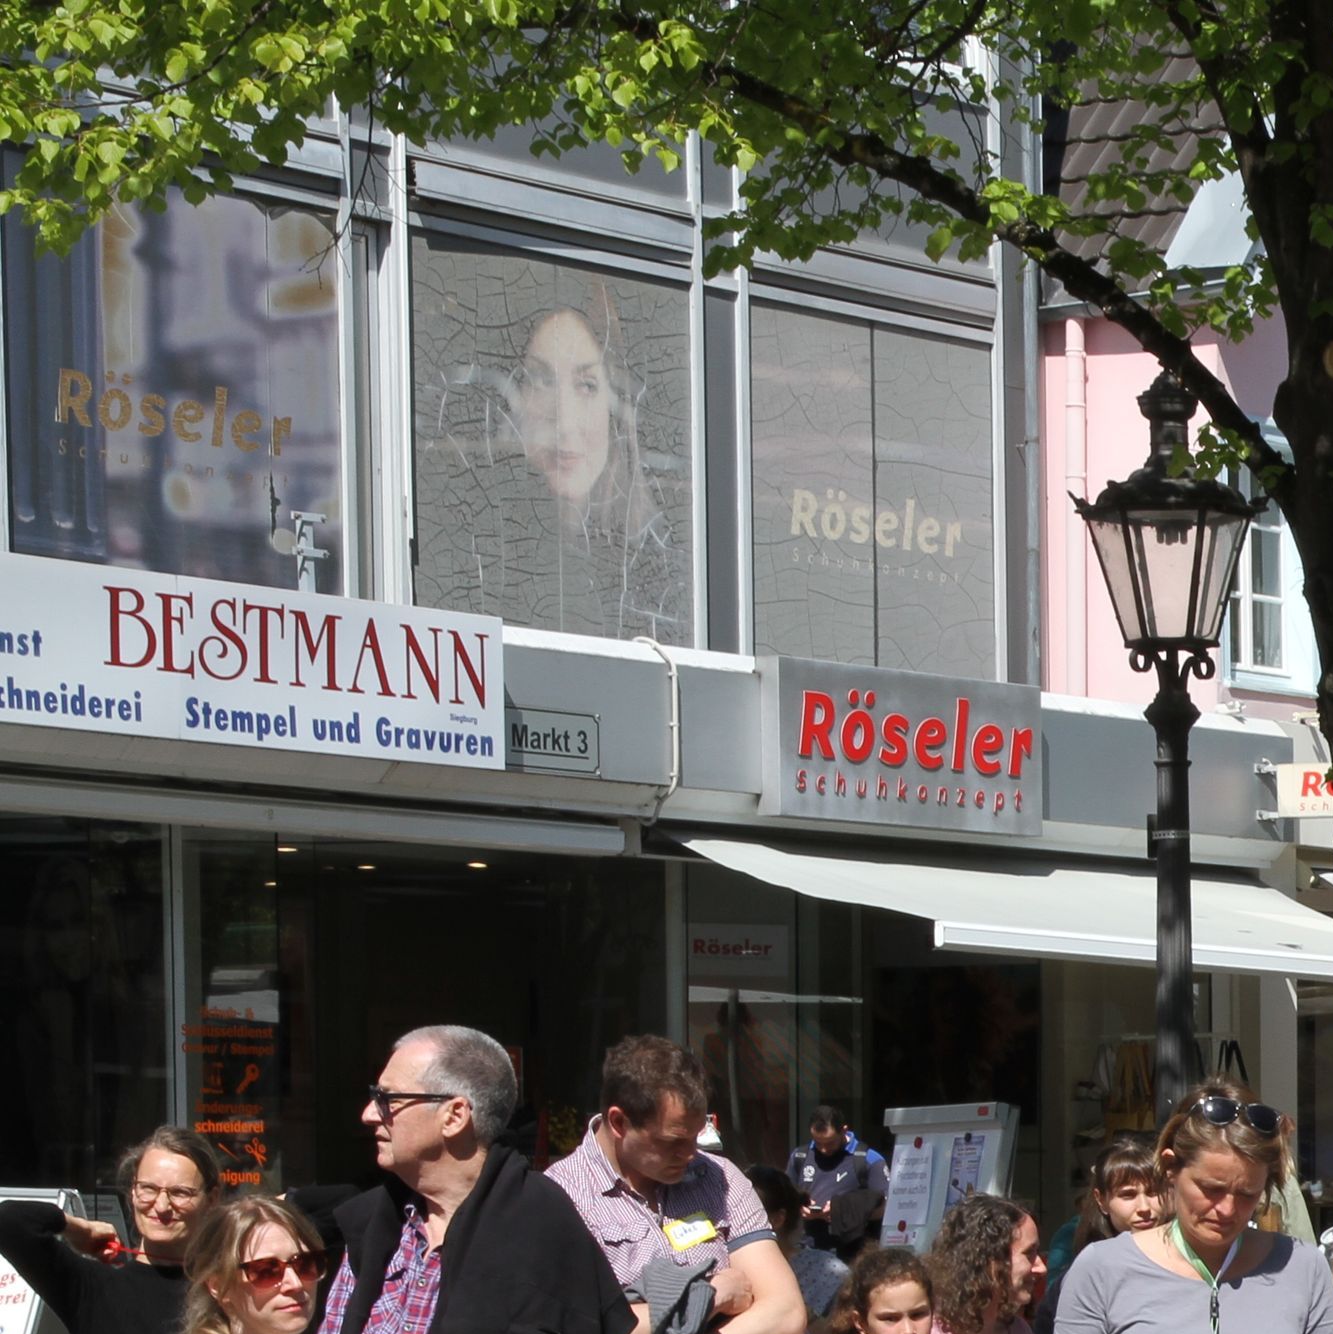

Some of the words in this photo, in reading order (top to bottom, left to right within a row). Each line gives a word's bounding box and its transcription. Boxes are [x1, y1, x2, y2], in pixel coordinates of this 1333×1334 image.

[57, 367, 293, 456] Röseler
[789, 488, 962, 557] Röseler
[793, 547, 961, 585] Schuhkonzept
[103, 585, 489, 710] BESTMANN
[186, 697, 297, 741] Stempel
[312, 714, 361, 745] und
[375, 716, 494, 757] Gravuren
[511, 723, 571, 753] Markt
[577, 730, 589, 754] 3
[798, 688, 1033, 778] Röseler
[796, 768, 1023, 815] Schuhkonzept
[692, 938, 774, 956] Röseler
[194, 1120, 265, 1134] schneiderei
